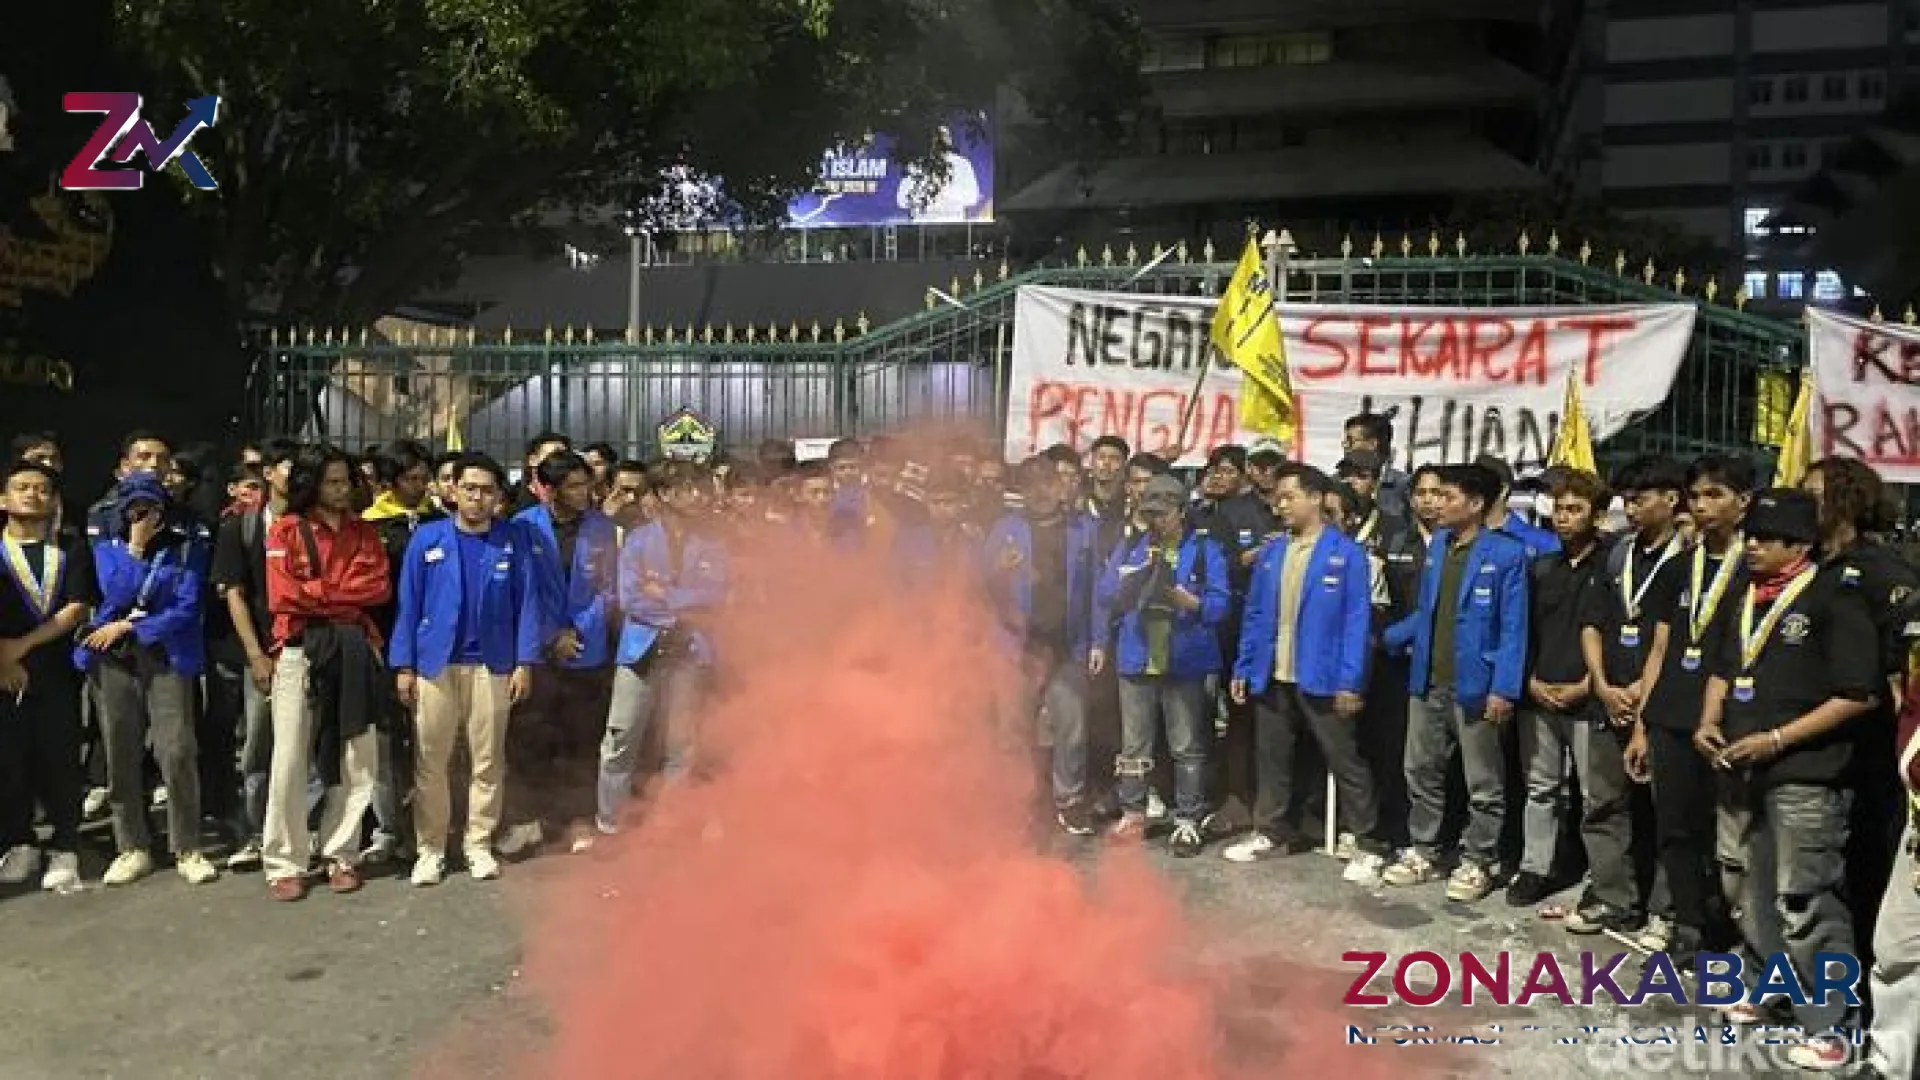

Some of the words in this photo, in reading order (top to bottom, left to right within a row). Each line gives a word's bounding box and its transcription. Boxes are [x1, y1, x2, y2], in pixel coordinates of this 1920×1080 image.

[830, 158, 887, 178] ISLAM
[1066, 302, 1237, 372] NEGA
[1301, 313, 1636, 386] SEKARAT
[1029, 380, 1305, 462] PENGUA
